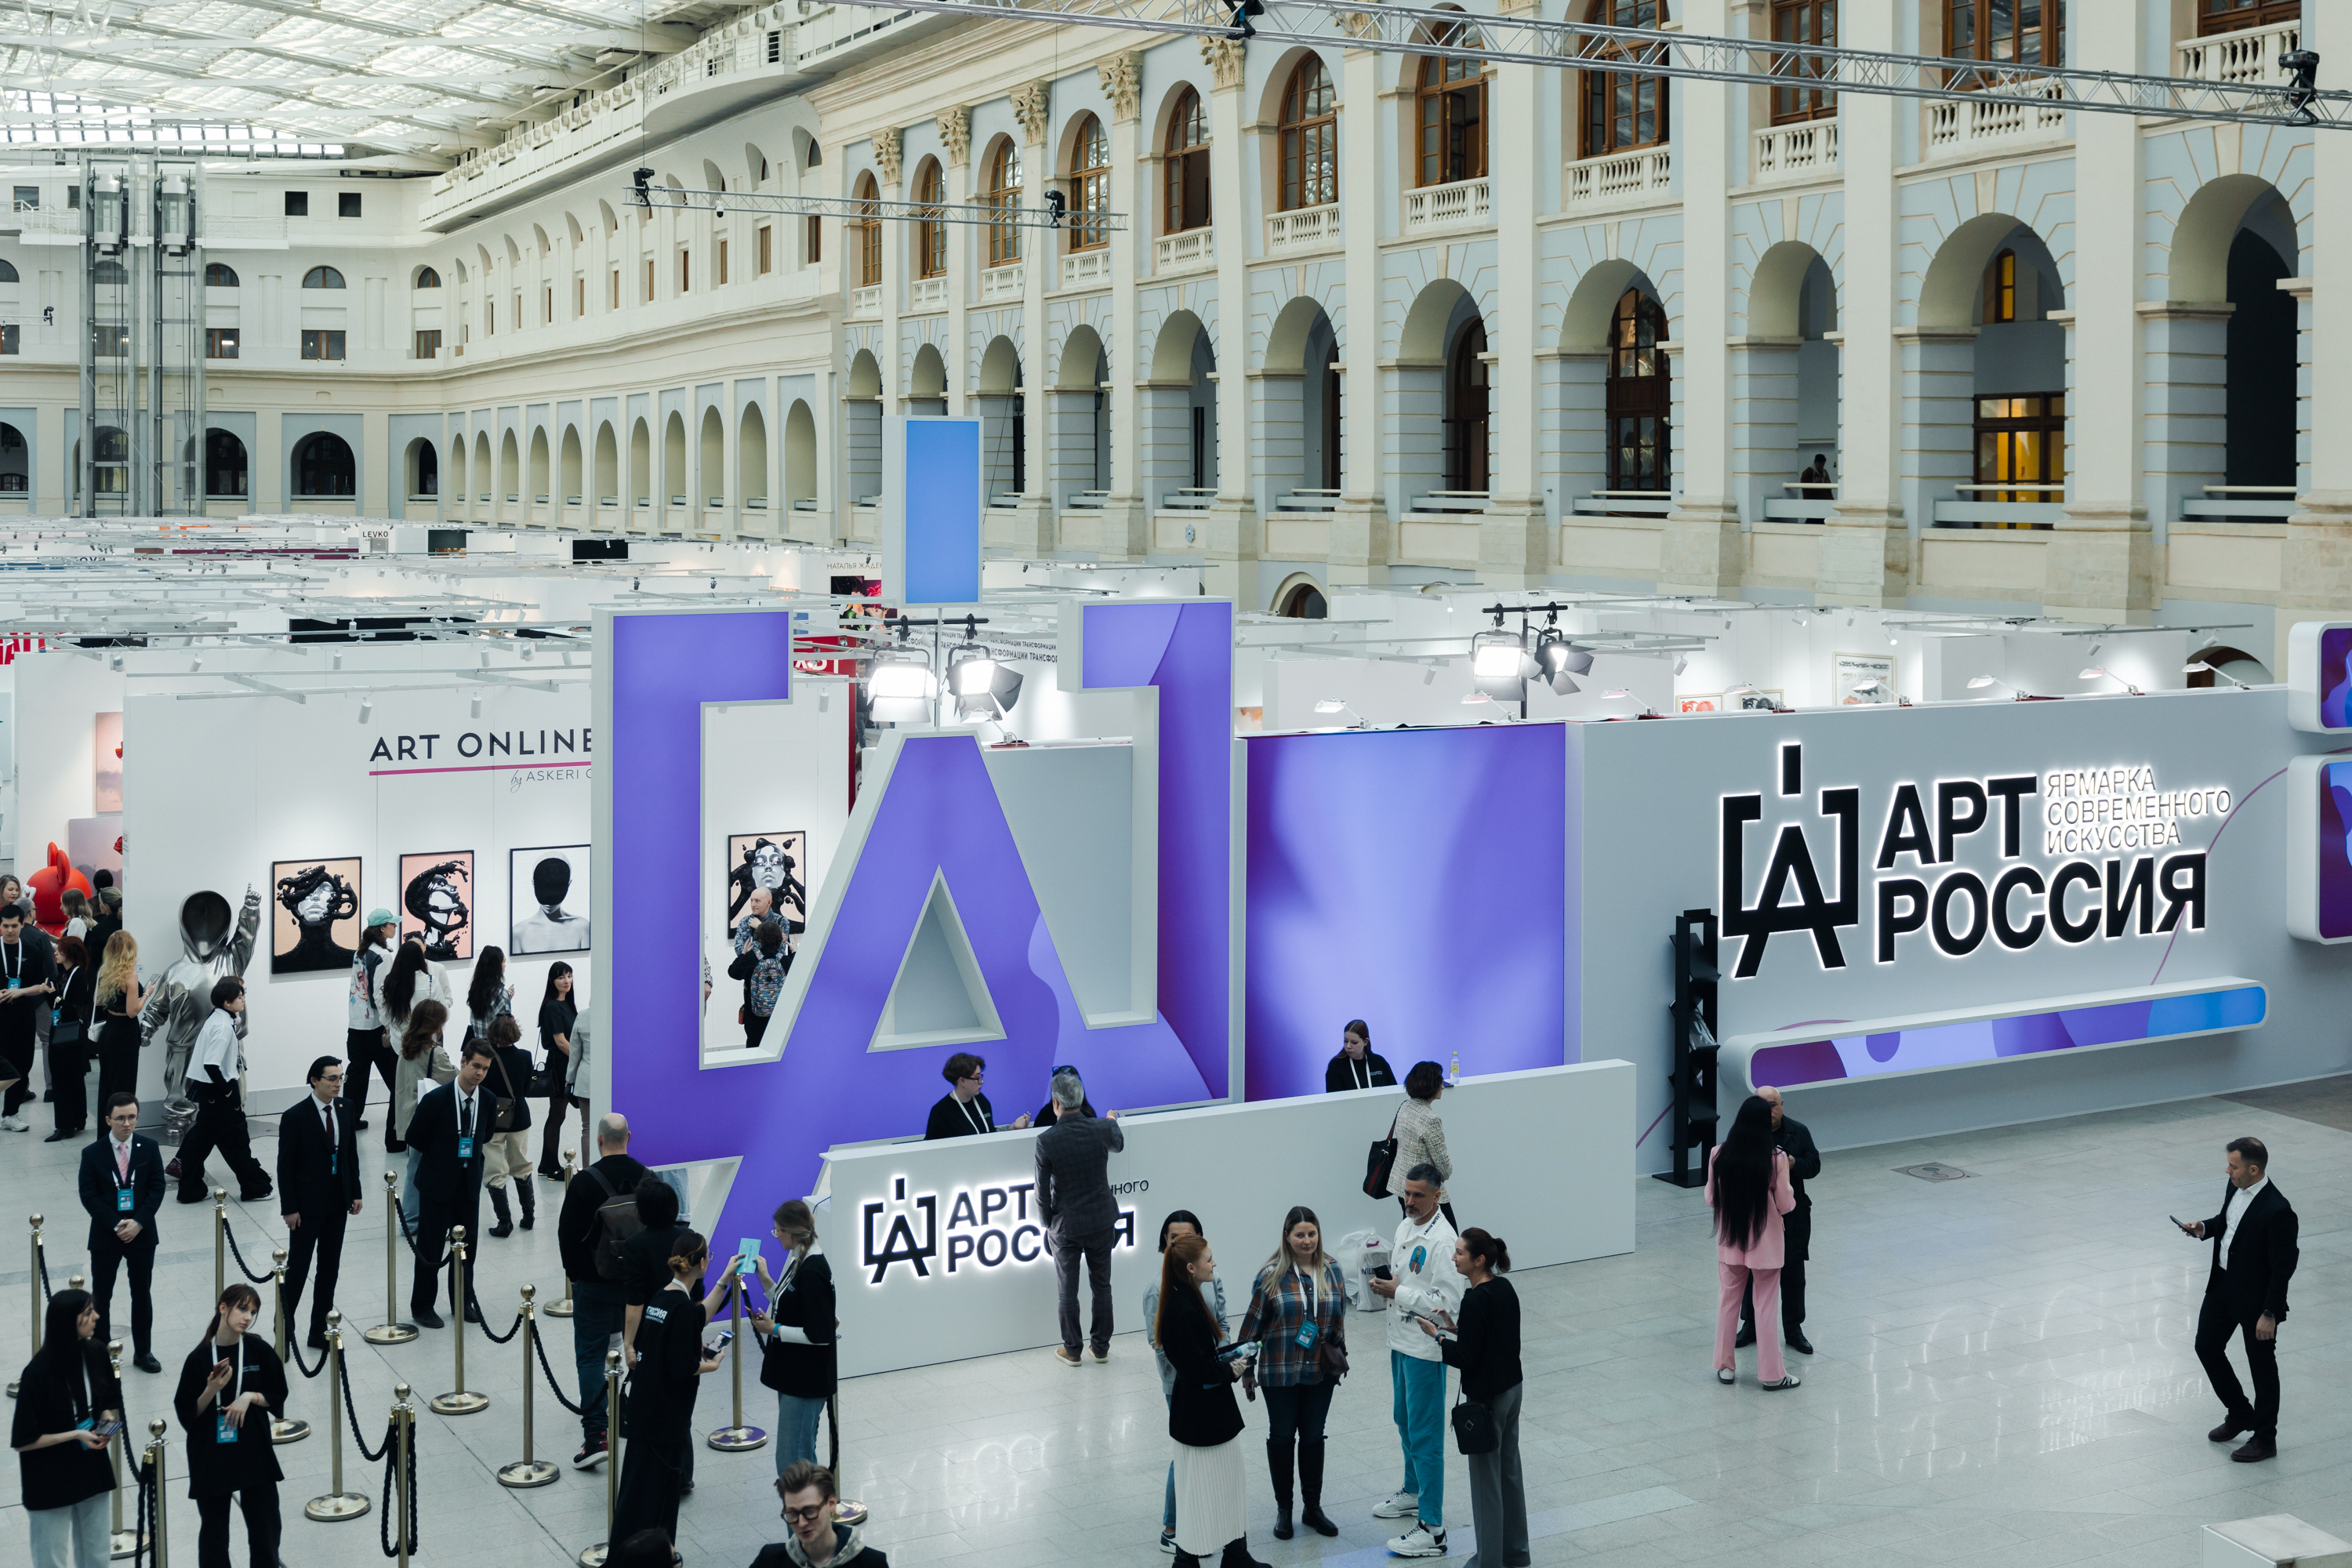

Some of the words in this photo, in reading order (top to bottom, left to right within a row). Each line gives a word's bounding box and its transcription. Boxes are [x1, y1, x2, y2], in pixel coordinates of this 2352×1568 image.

[368, 734, 441, 762] ART
[510, 769, 523, 793] by
[525, 769, 579, 782] ASKERI
[2045, 767, 2156, 798] ЯРМАРКА
[1876, 775, 2037, 869] АРТ
[2047, 789, 2231, 826] СОВРЕМЕННОГО
[2047, 821, 2182, 855] ИСКУССТВА
[1878, 852, 2206, 964] РОССИЯ
[946, 1182, 1035, 1231] АРТ
[947, 1210, 1134, 1272] РОСЯ
